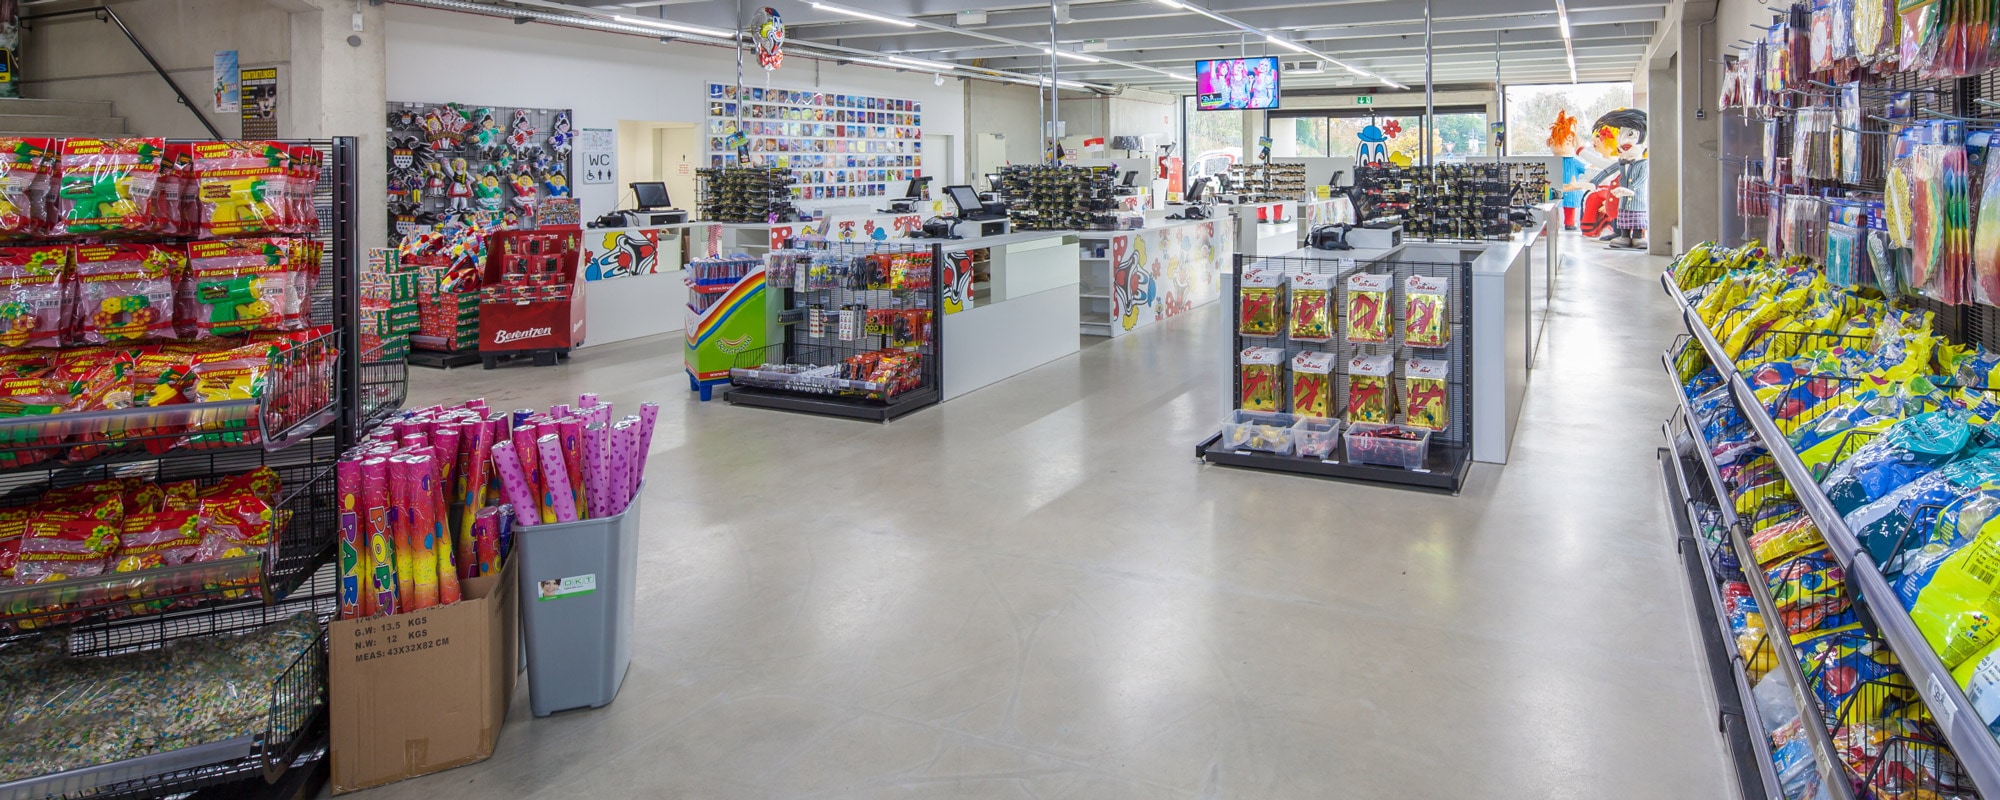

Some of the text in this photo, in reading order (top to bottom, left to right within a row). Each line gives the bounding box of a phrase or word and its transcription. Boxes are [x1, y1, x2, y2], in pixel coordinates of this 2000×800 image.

[588, 154, 610, 166] WC
[213, 169, 240, 177] ORIGINAL
[494, 327, 552, 343] Berentzen
[355, 617, 427, 637] G.W: 13.5 KGS
[355, 629, 427, 650] N.W: 12 KGS
[355, 637, 449, 662] MEAS: 43X32X82 CM
